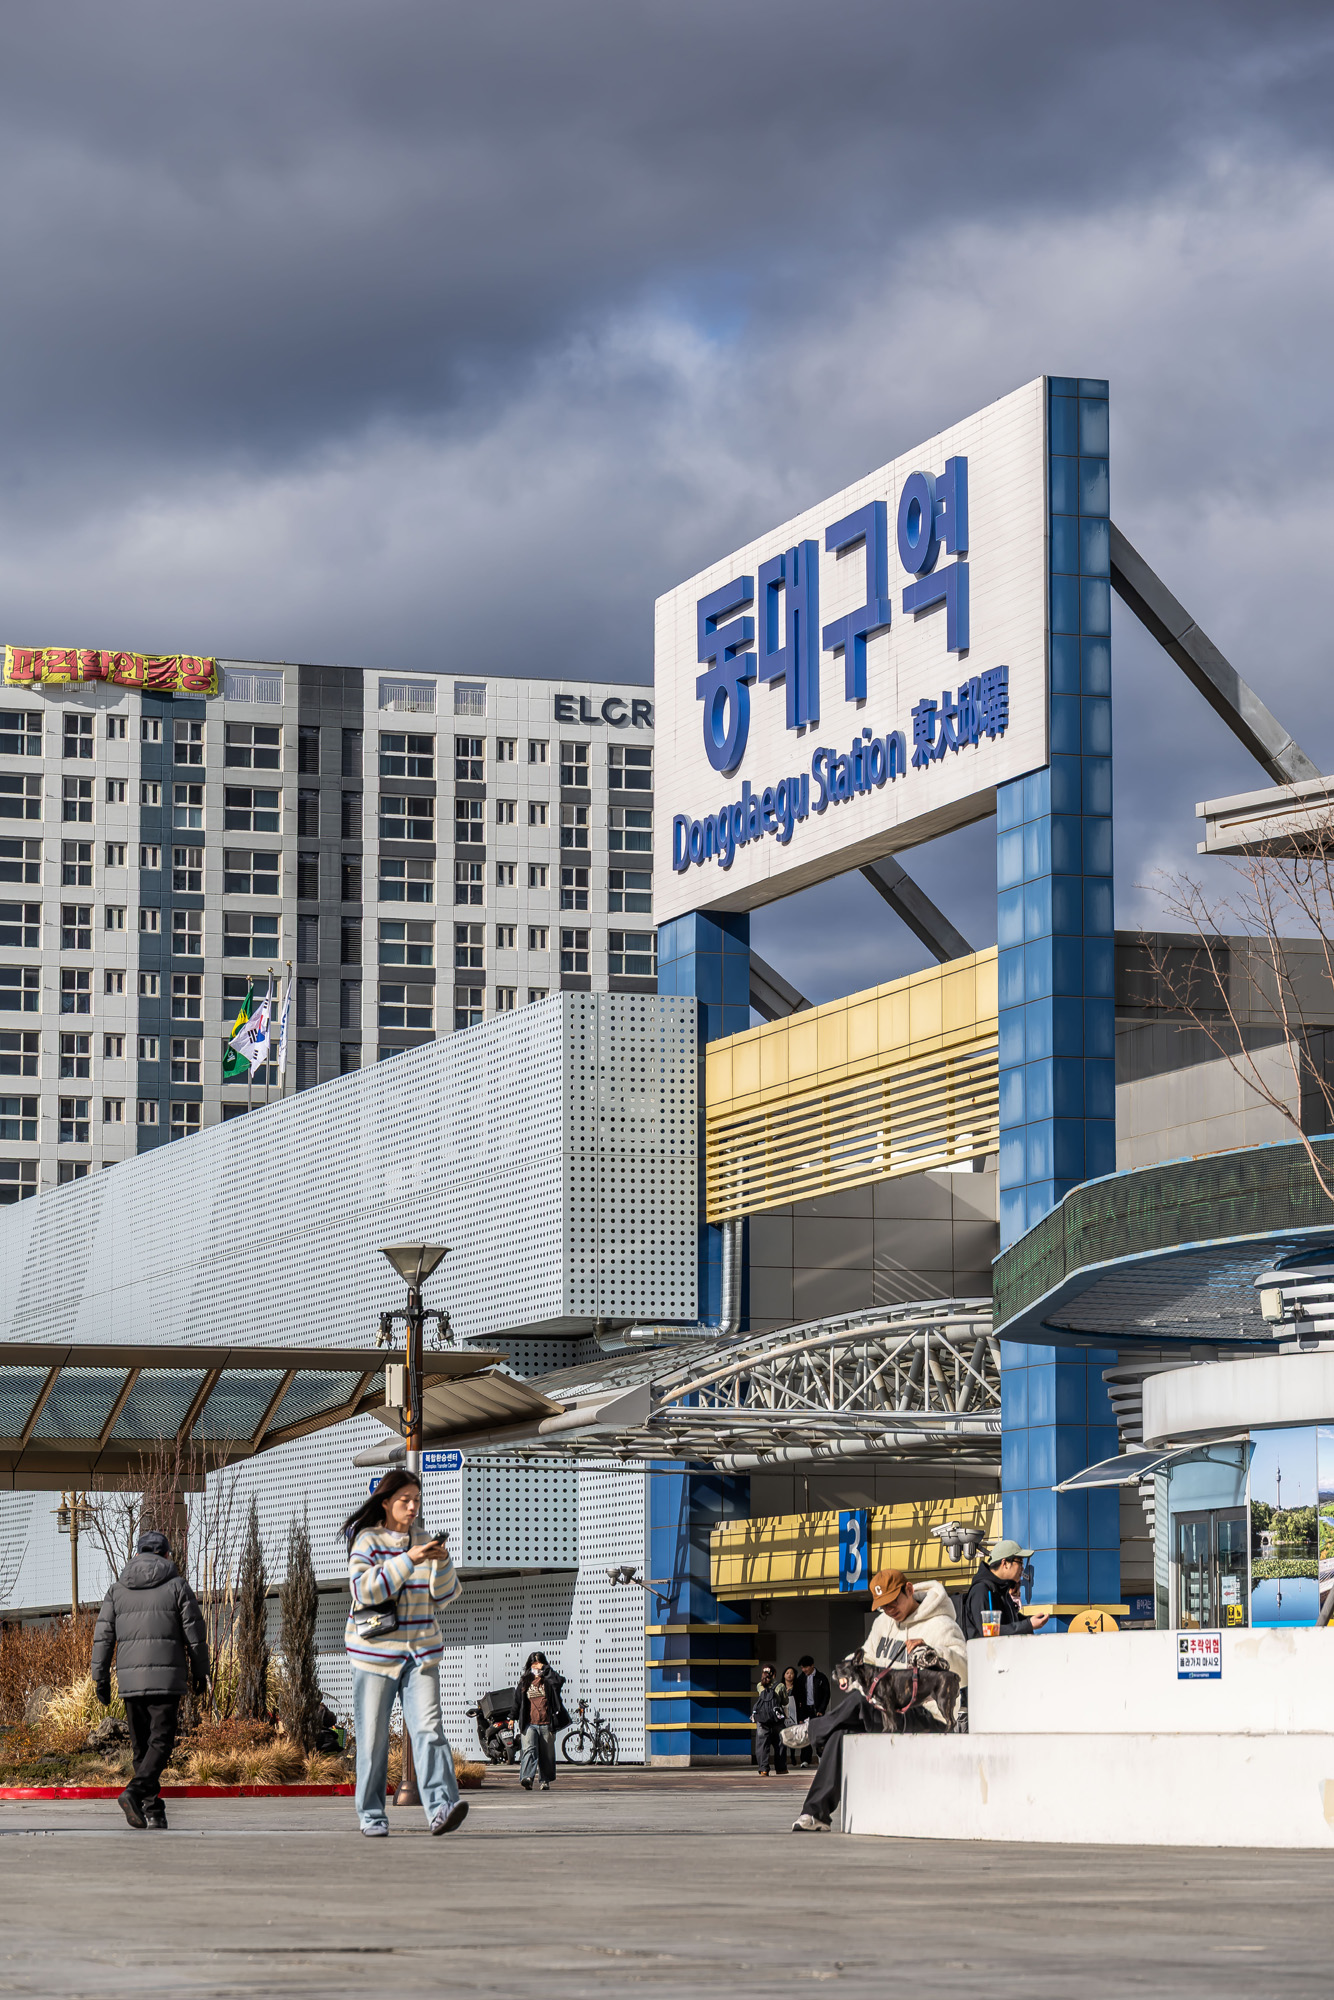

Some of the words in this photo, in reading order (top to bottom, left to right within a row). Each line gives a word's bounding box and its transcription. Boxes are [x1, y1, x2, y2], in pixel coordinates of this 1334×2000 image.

[696, 456, 969, 771] 동대구역
[672, 773, 809, 871] Dongdaegu
[811, 727, 907, 812] Station
[846, 1518, 861, 1584] 3
[874, 1585, 883, 1596] C
[1190, 1639, 1219, 1654] 추락위험
[1202, 1657, 1219, 1667] 마시오
